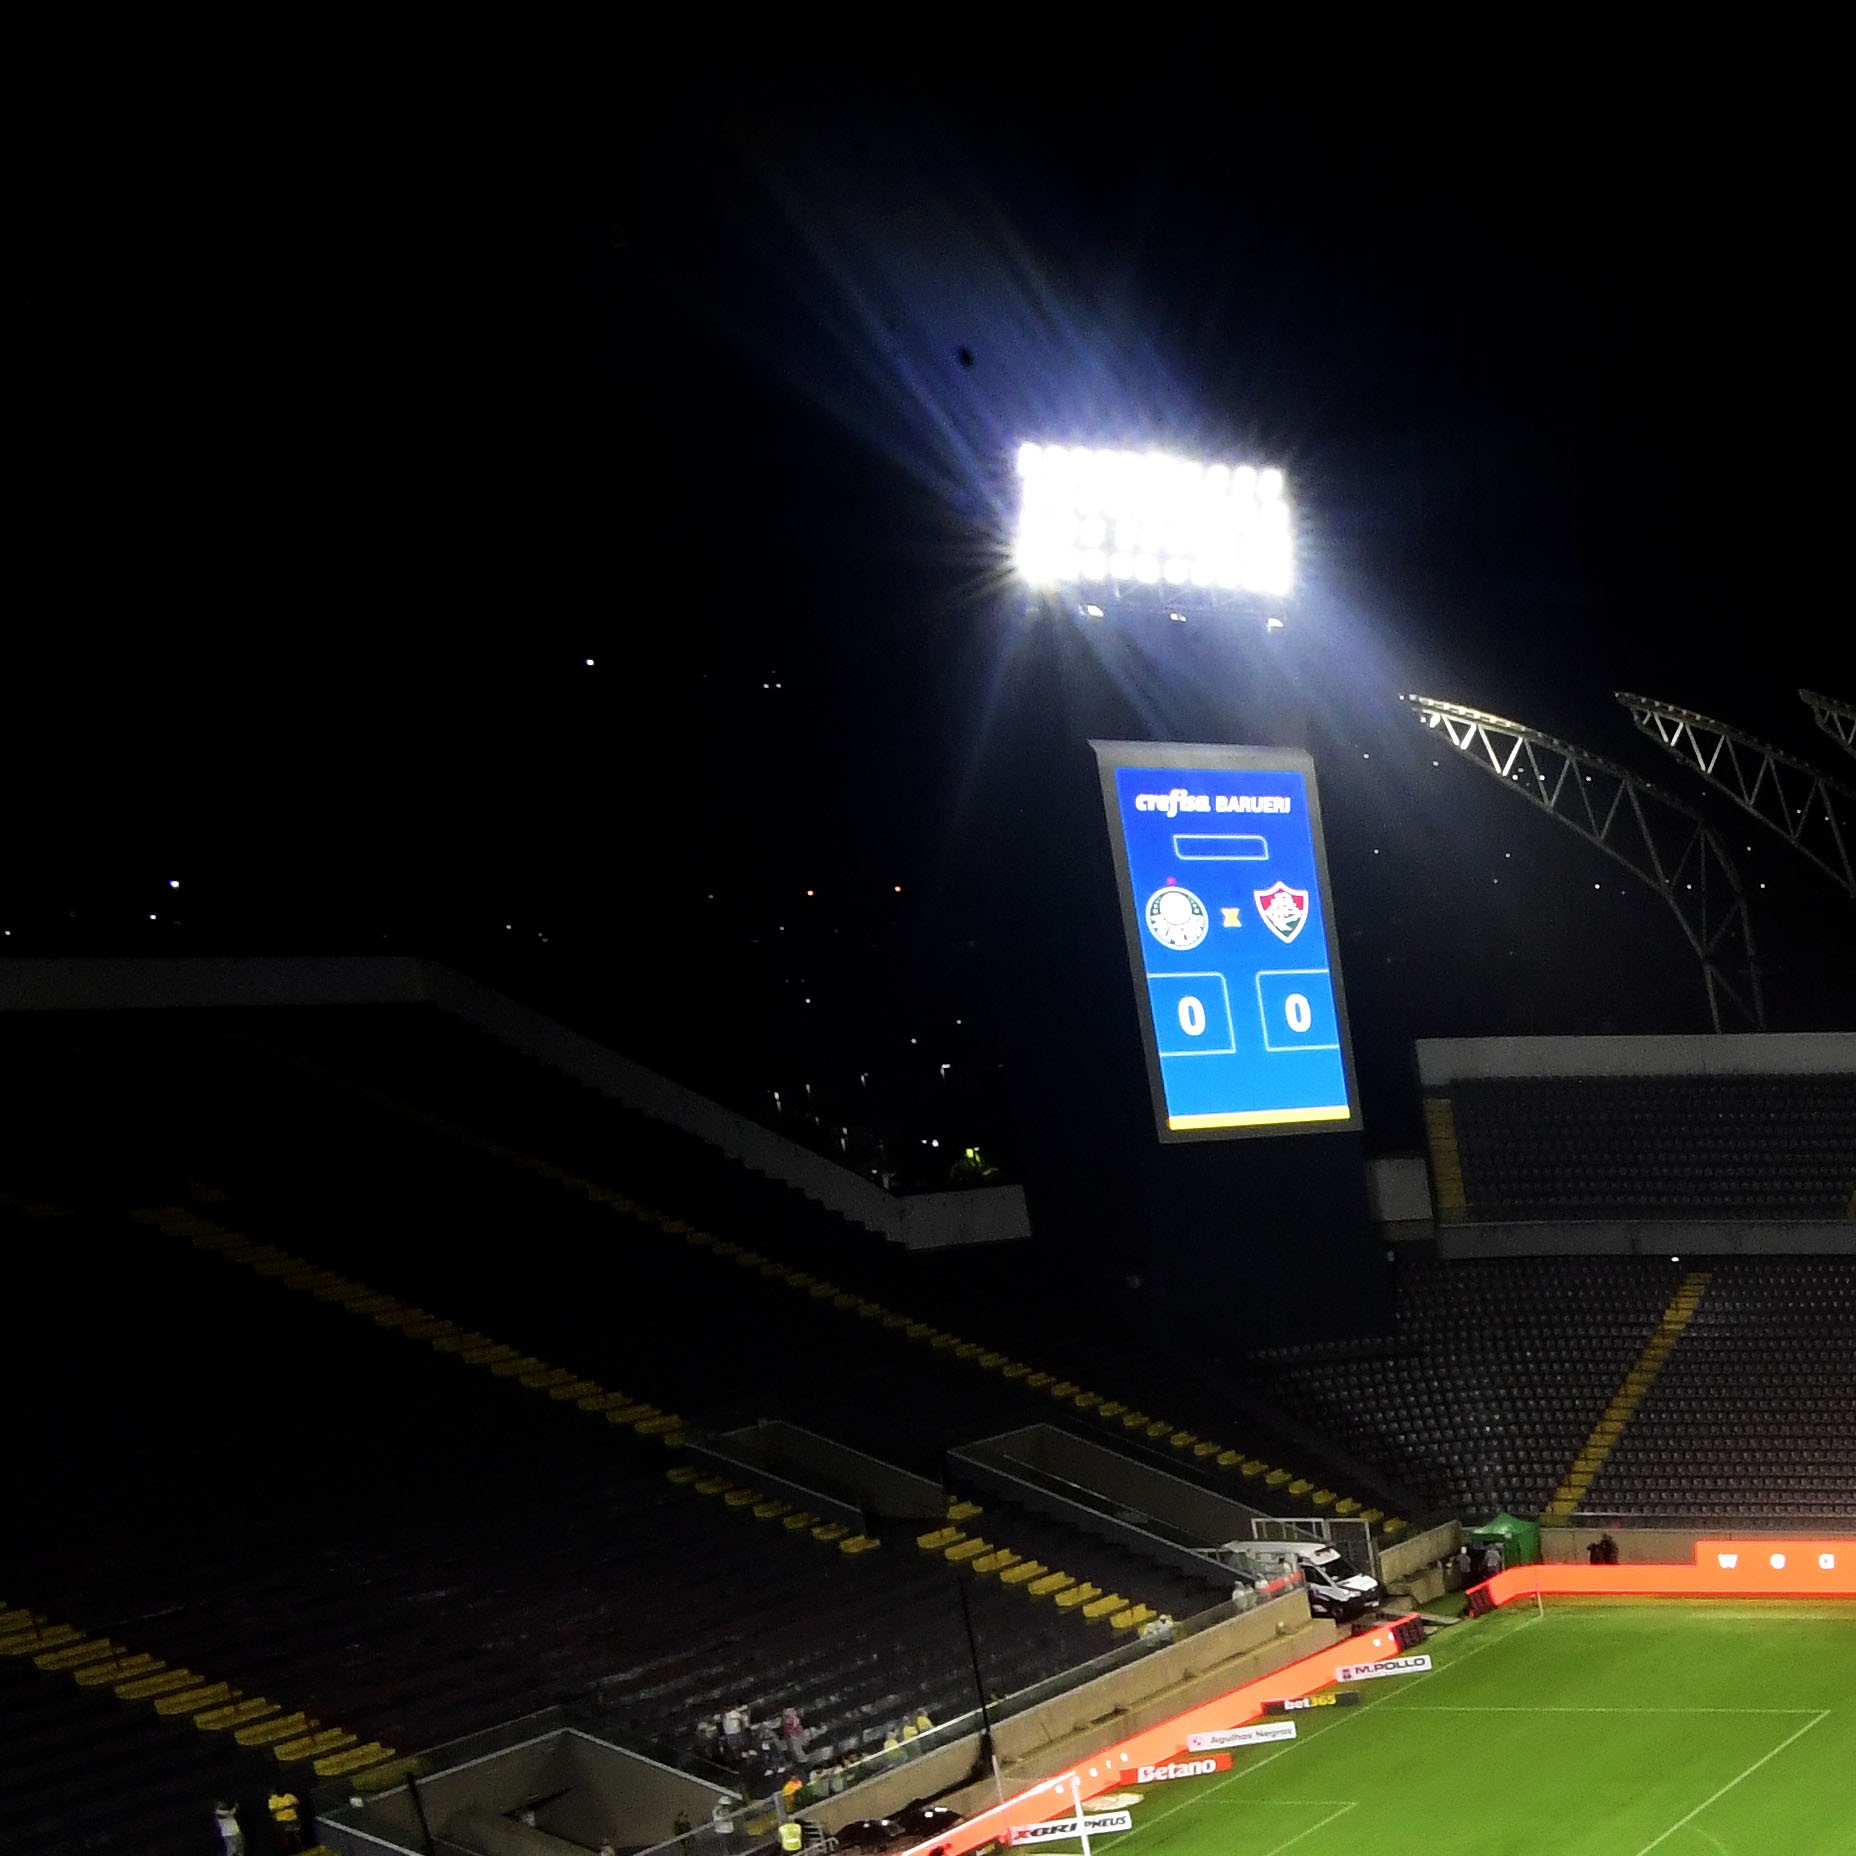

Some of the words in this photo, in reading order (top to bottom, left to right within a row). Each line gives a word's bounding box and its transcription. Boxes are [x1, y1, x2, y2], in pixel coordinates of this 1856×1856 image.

[1215, 796, 1291, 814] BARUERI
[1178, 996, 1206, 1036] 0
[1284, 993, 1312, 1033] 0
[1354, 1658, 1426, 1675] M.POLLO
[1137, 1759, 1217, 1784] Betano
